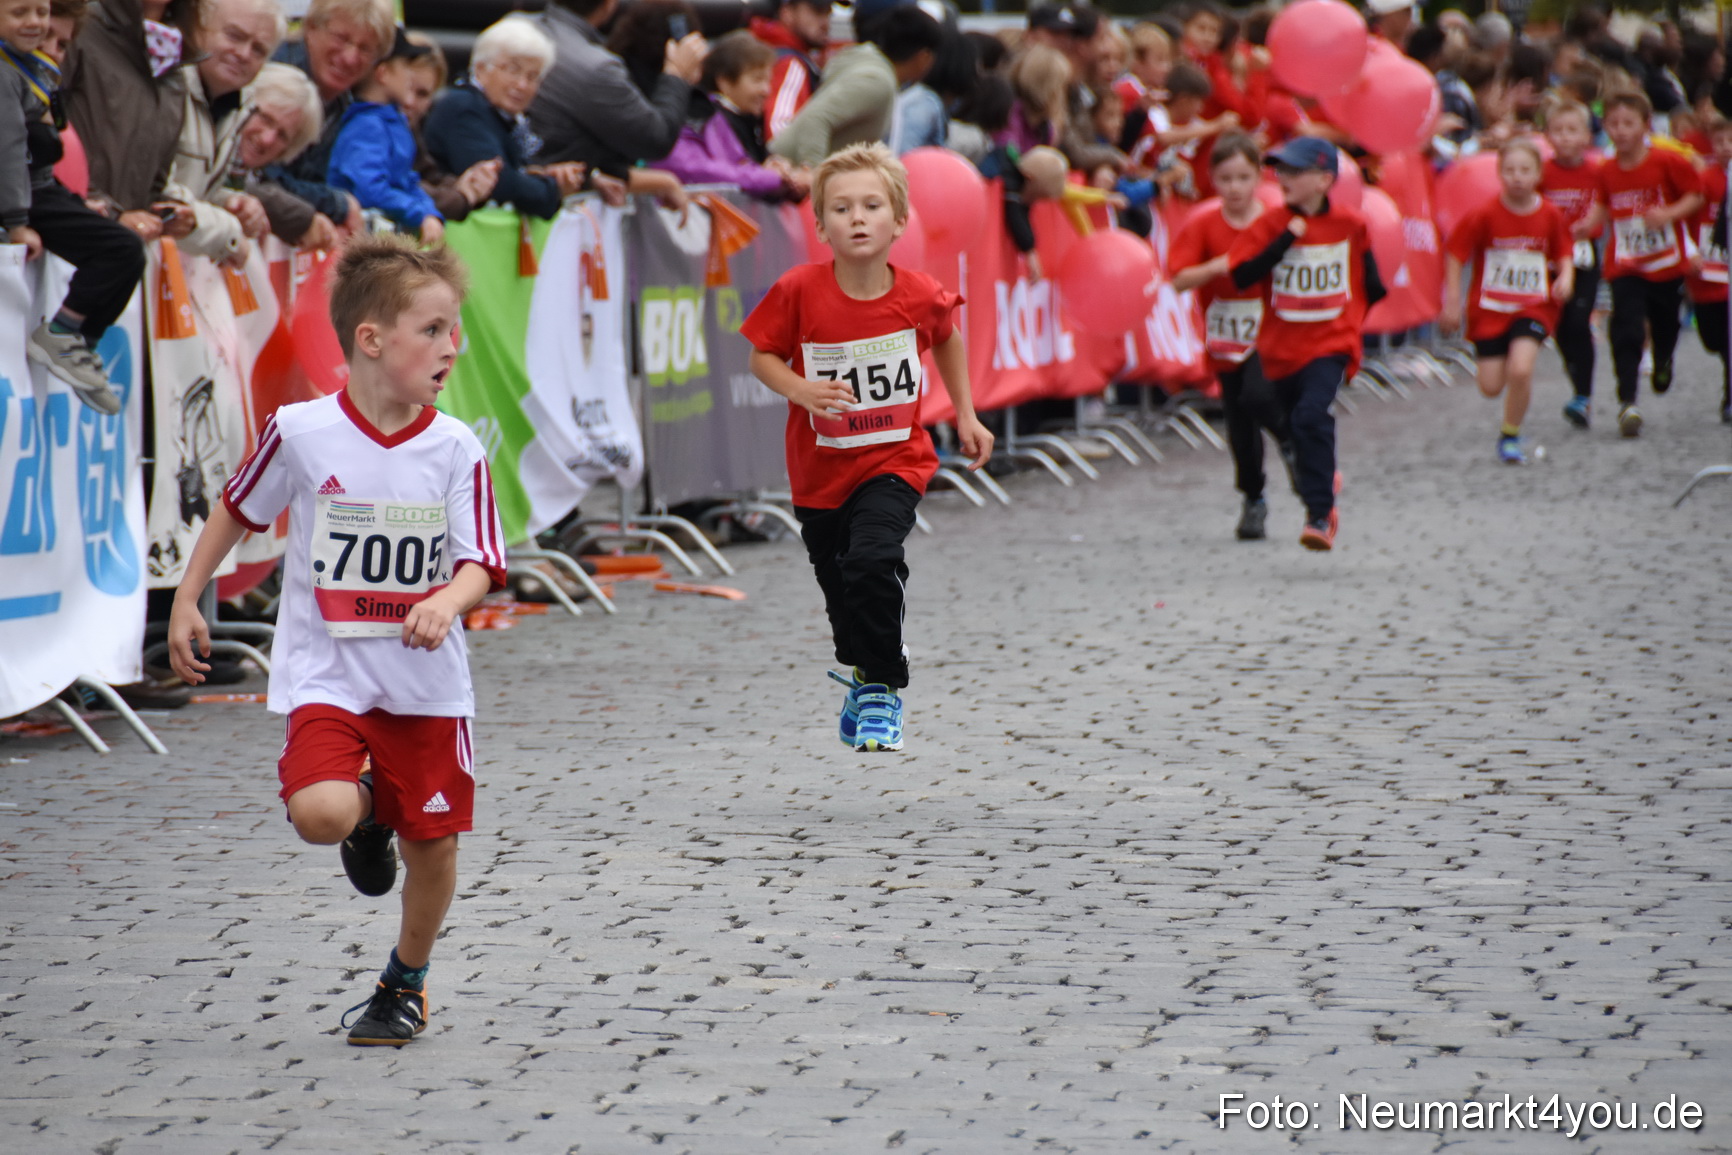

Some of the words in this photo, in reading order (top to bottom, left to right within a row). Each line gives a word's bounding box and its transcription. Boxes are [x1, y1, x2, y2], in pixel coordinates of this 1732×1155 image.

[1281, 263, 1341, 291] 7003
[853, 335, 907, 357] BOCK
[812, 354, 847, 362] NeuerMarkt
[816, 358, 916, 403] 7154
[848, 414, 893, 432] Kilian
[326, 511, 376, 523] NeuerMarkt
[329, 531, 445, 585] 7005
